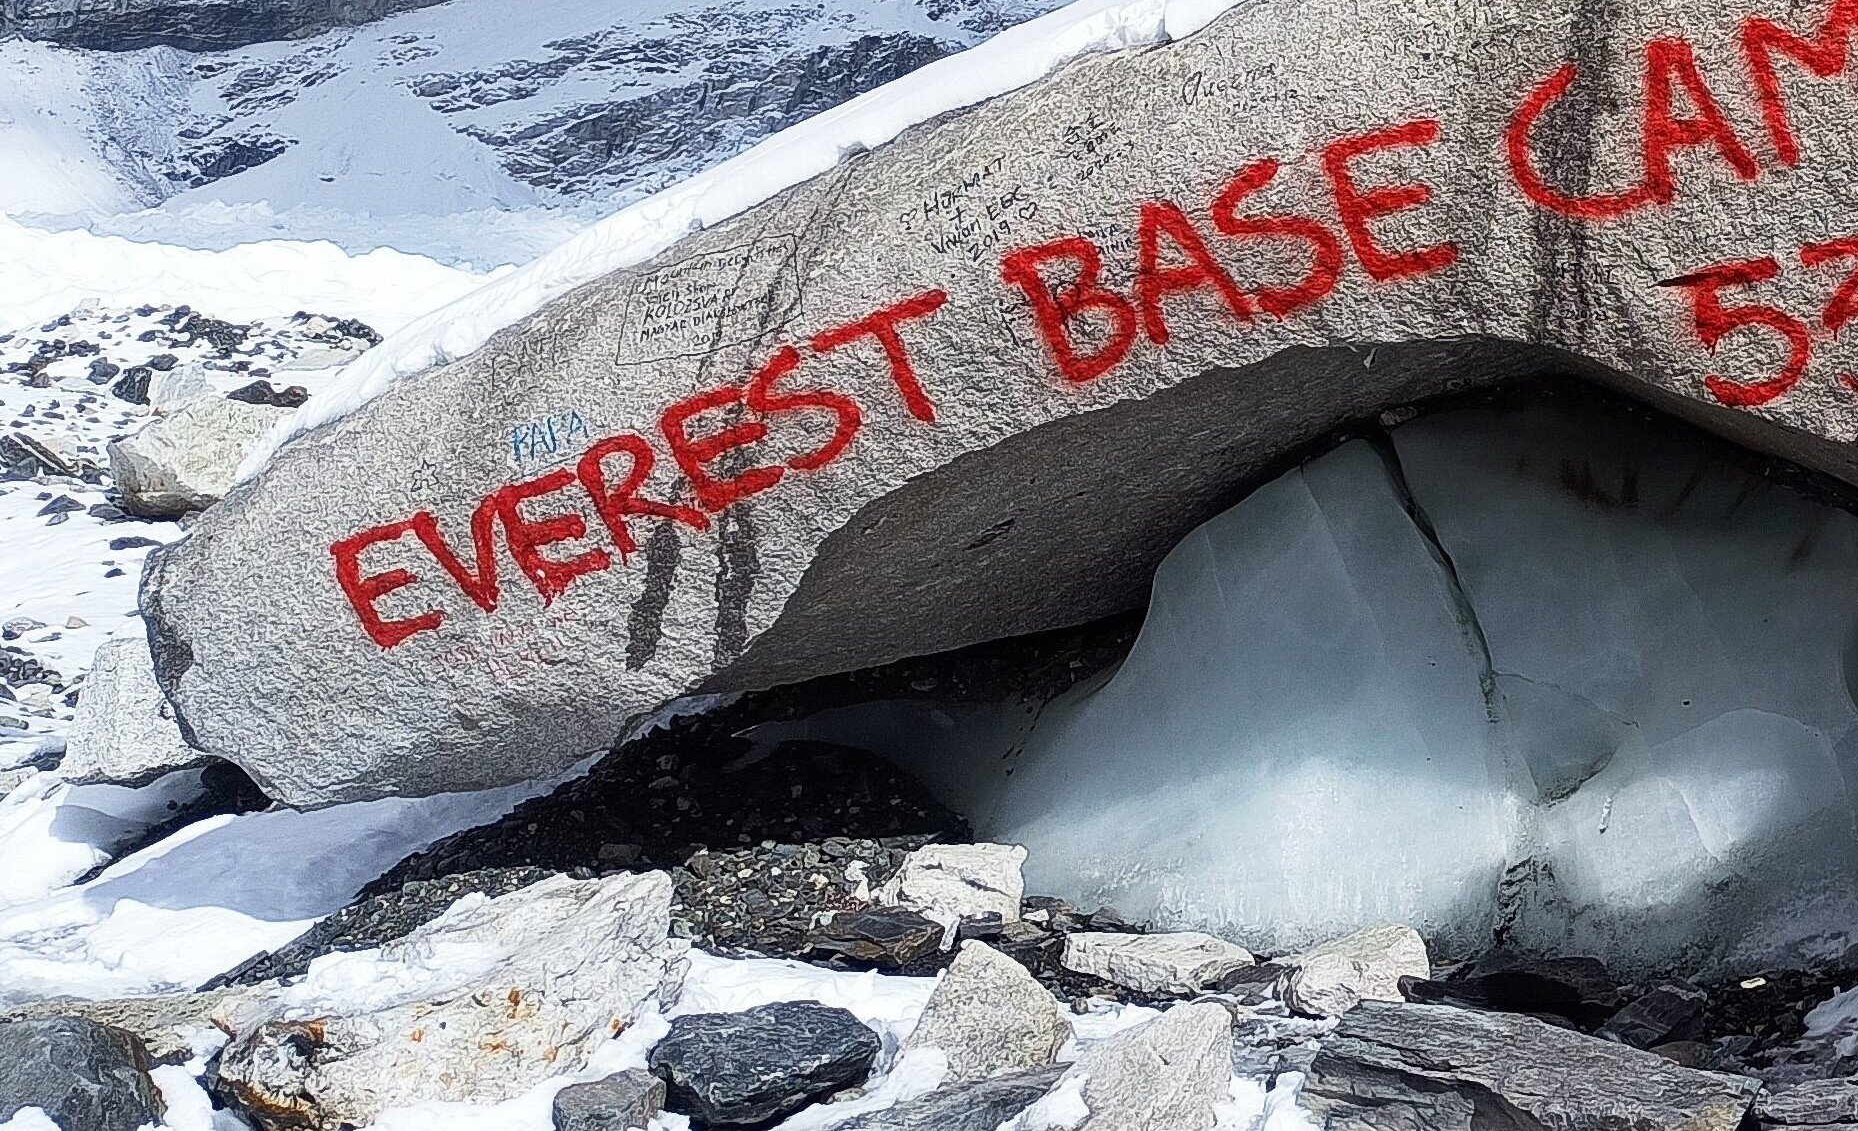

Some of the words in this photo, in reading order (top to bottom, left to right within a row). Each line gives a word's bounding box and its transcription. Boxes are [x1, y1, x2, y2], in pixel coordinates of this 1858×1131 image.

[330, 290, 948, 650] EVEREST
[1002, 118, 1460, 386] BASE
[966, 219, 1011, 262] 2019
